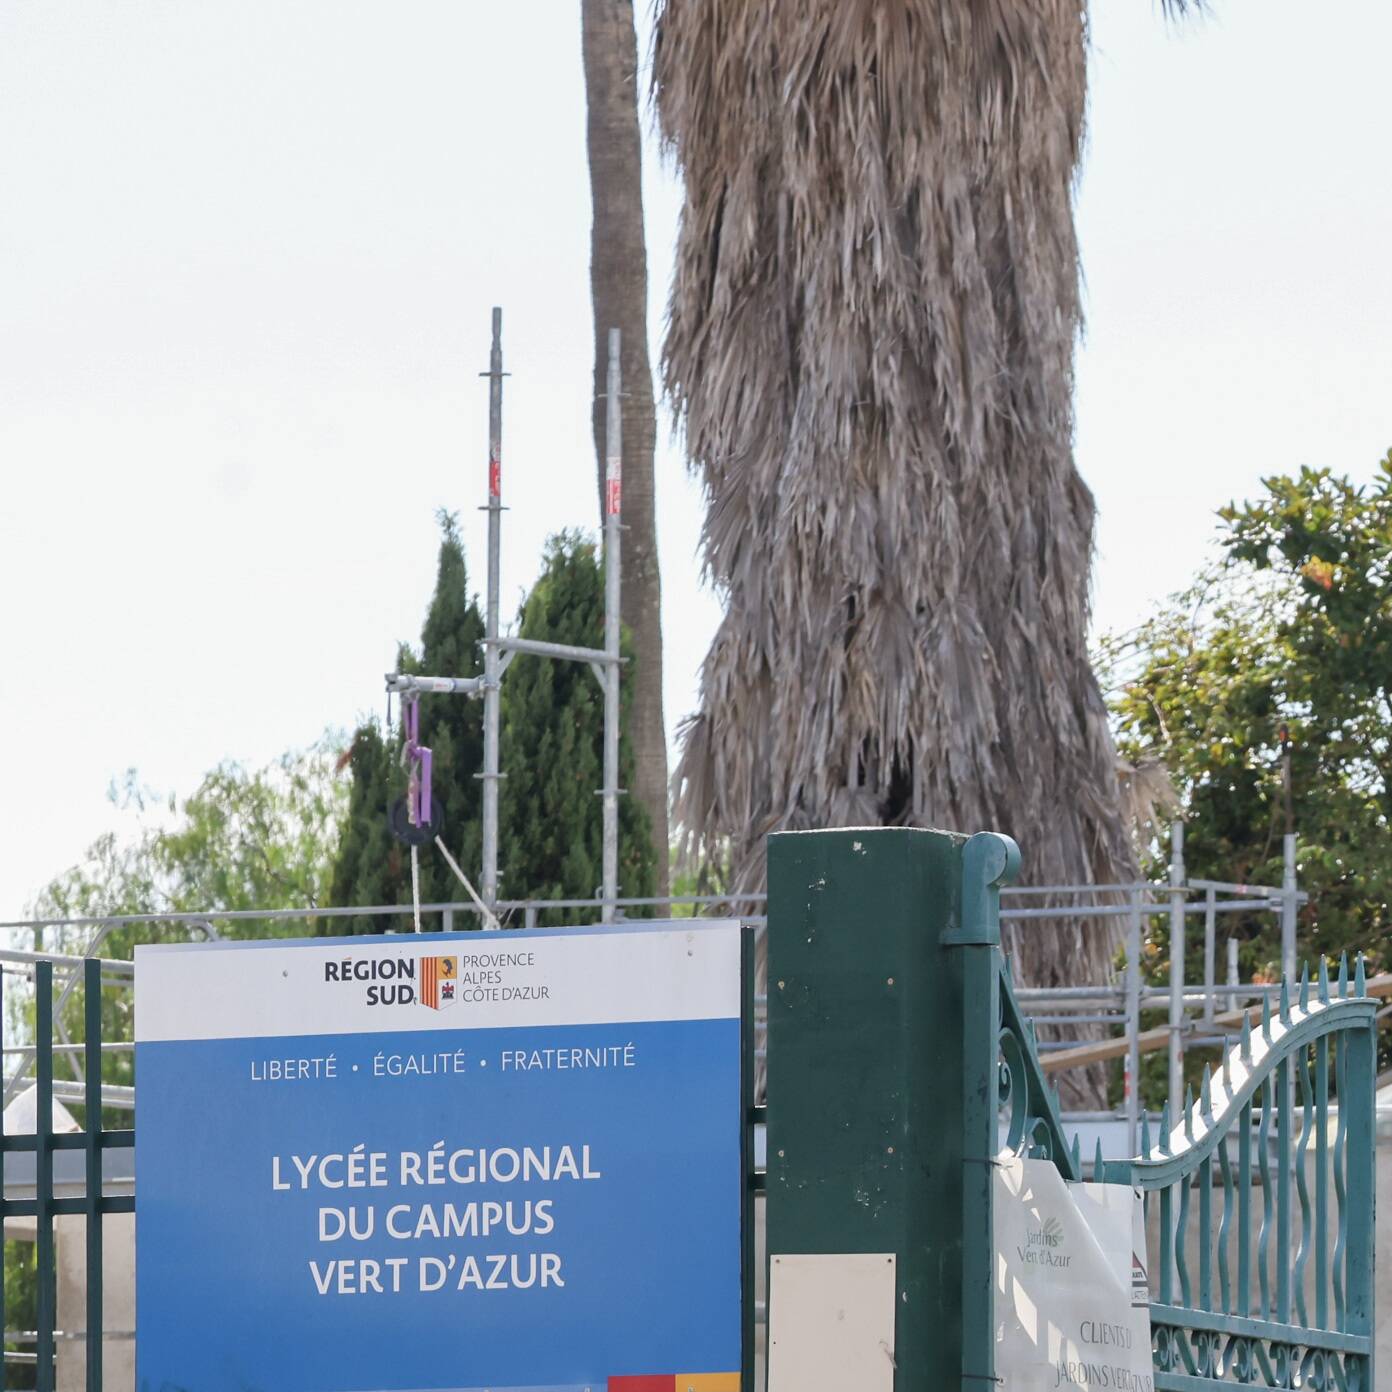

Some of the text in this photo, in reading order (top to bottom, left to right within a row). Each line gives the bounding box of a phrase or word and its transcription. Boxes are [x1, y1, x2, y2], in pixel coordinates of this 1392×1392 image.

[325, 956, 415, 981] RÉGION
[463, 953, 535, 968] PROVENCE
[463, 971, 502, 984] ALPES
[367, 984, 414, 1006] SUD
[463, 986, 499, 1003] CÔTE
[251, 1042, 636, 1081] LIBERTÉ ÉGALITÉ FRATERNITÉ
[272, 1140, 601, 1190] LYCÉE RÉGIONAL
[319, 1200, 555, 1242] DU CAMPUS
[1026, 1228, 1058, 1248] Jardins
[309, 1257, 408, 1295] VERT
[1080, 1320, 1124, 1348] CLIENTS
[1054, 1360, 1109, 1388] JARDINS
